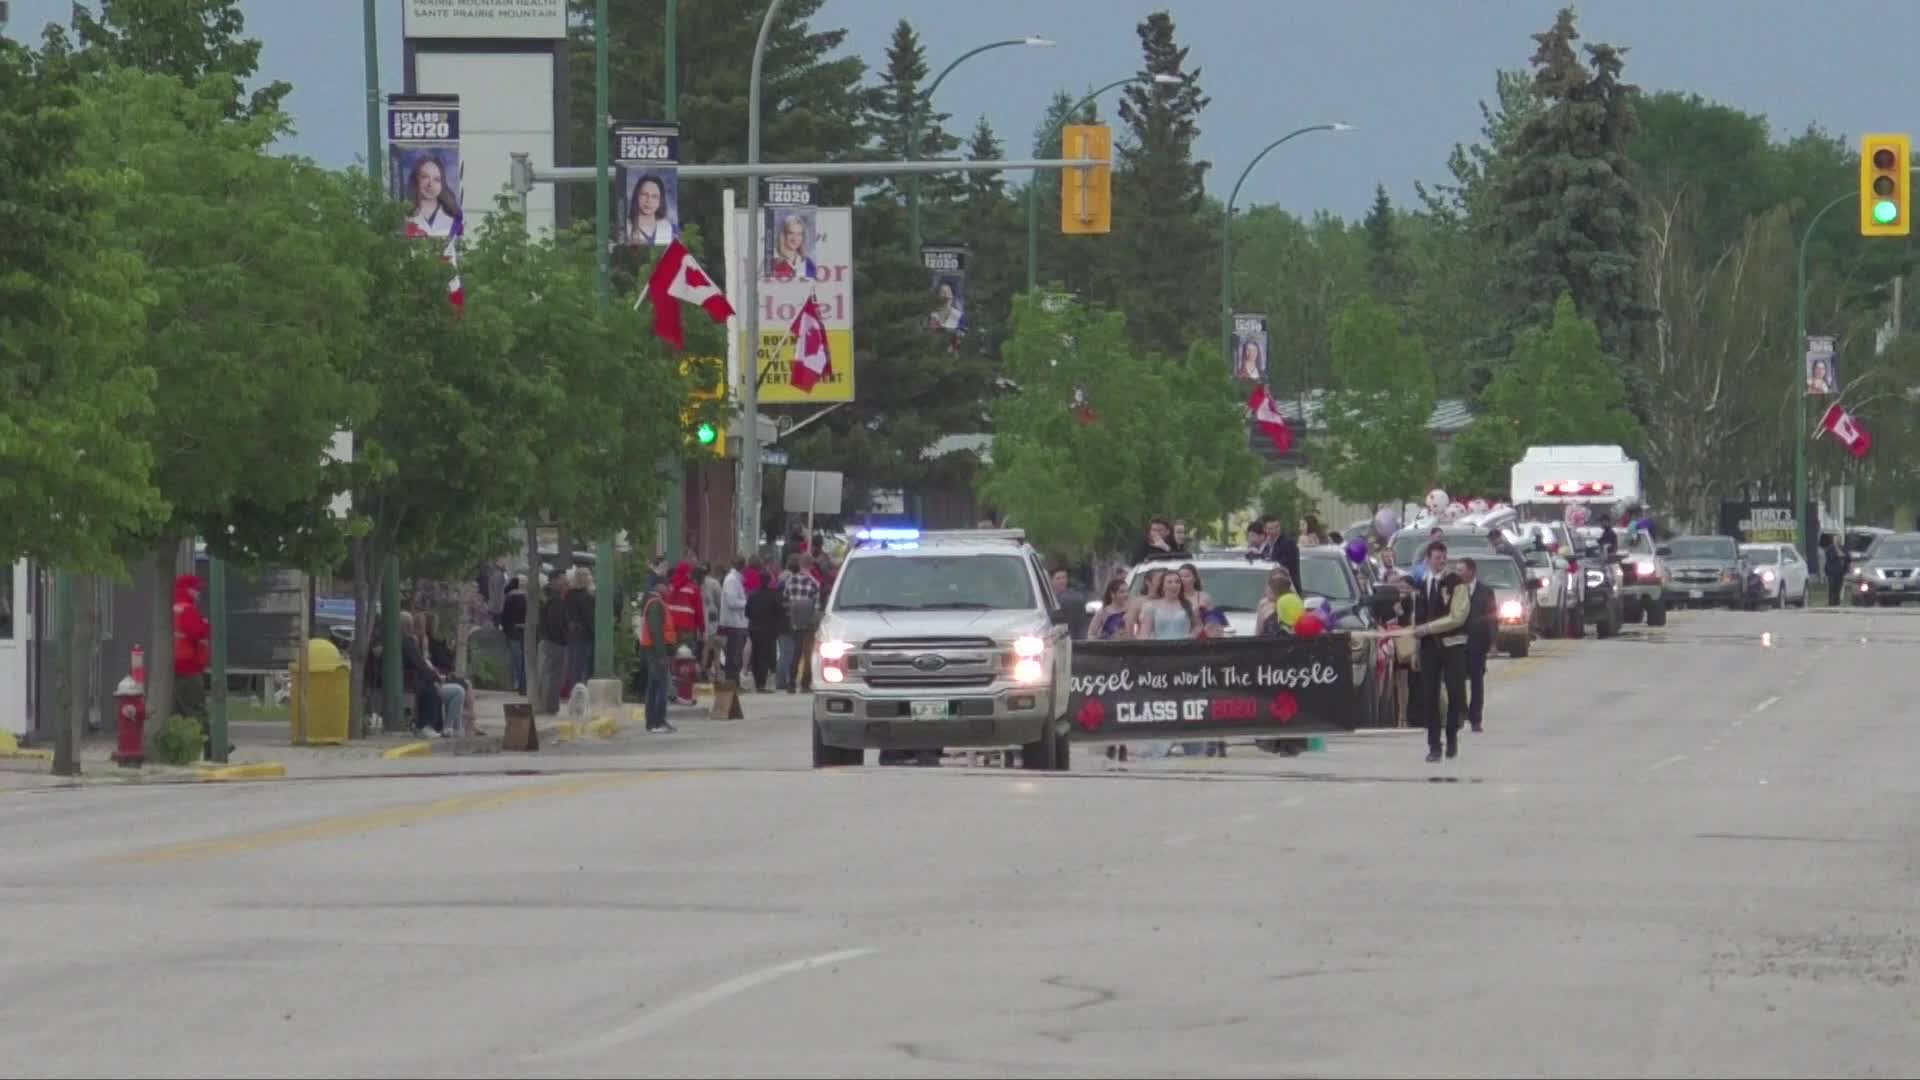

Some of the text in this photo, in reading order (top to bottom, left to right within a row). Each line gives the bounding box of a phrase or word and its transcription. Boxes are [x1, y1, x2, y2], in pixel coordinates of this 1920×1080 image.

[453, 9, 494, 18] PRAIRIE
[498, 9, 557, 18] MOUNTAIN
[401, 122, 449, 138] 2020
[627, 144, 669, 159] 2020
[775, 191, 810, 204] 2020
[1070, 668, 1135, 697] assel
[1173, 665, 1218, 689] worth
[1221, 665, 1252, 687] The
[1257, 663, 1339, 689] Hassle
[1116, 701, 1177, 722] CLASS
[1182, 699, 1209, 721] OF
